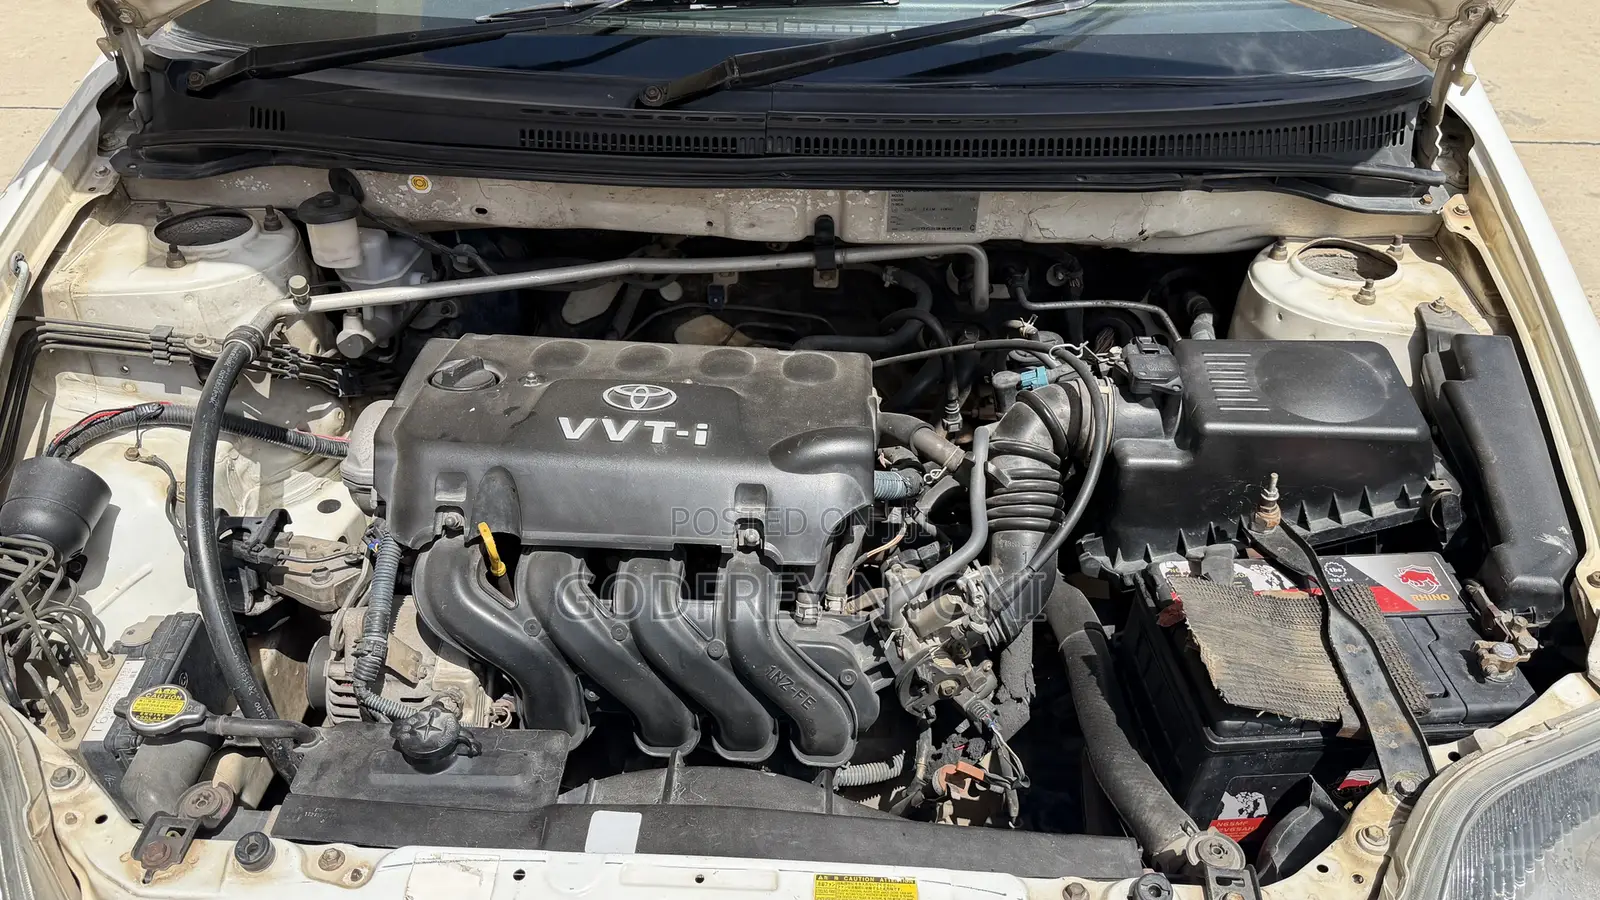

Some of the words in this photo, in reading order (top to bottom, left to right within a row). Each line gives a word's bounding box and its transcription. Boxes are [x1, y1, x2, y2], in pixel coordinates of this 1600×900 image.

[557, 416, 710, 447] VVT-i
[1411, 593, 1450, 601] RHINO
[145, 692, 183, 701] CAUTION
[764, 664, 817, 711] 1NZ-FE
